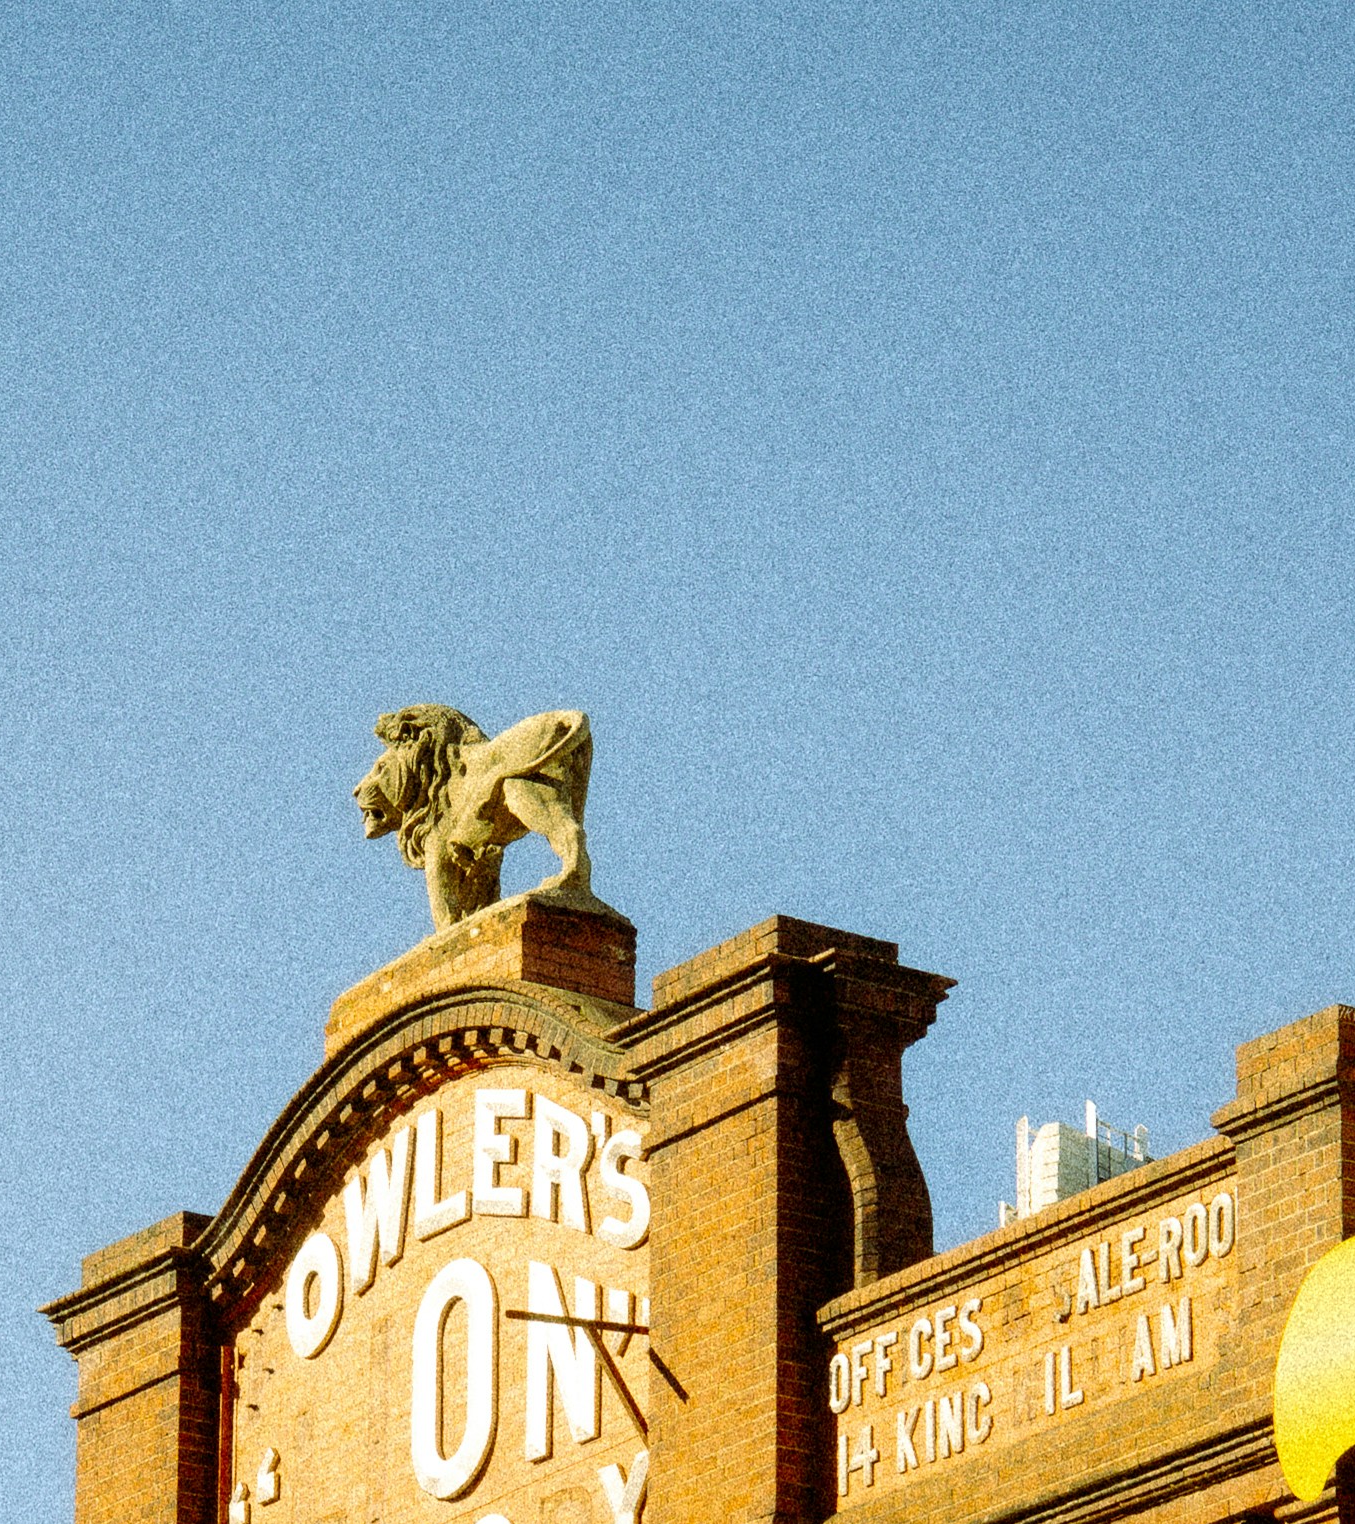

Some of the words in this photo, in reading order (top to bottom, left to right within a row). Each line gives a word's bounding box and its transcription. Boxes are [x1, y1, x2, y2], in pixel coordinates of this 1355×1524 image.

[285, 1088, 651, 1361] OWLER'S
[829, 1298, 985, 1414] OFFCES
[837, 1425, 880, 1497] 14
